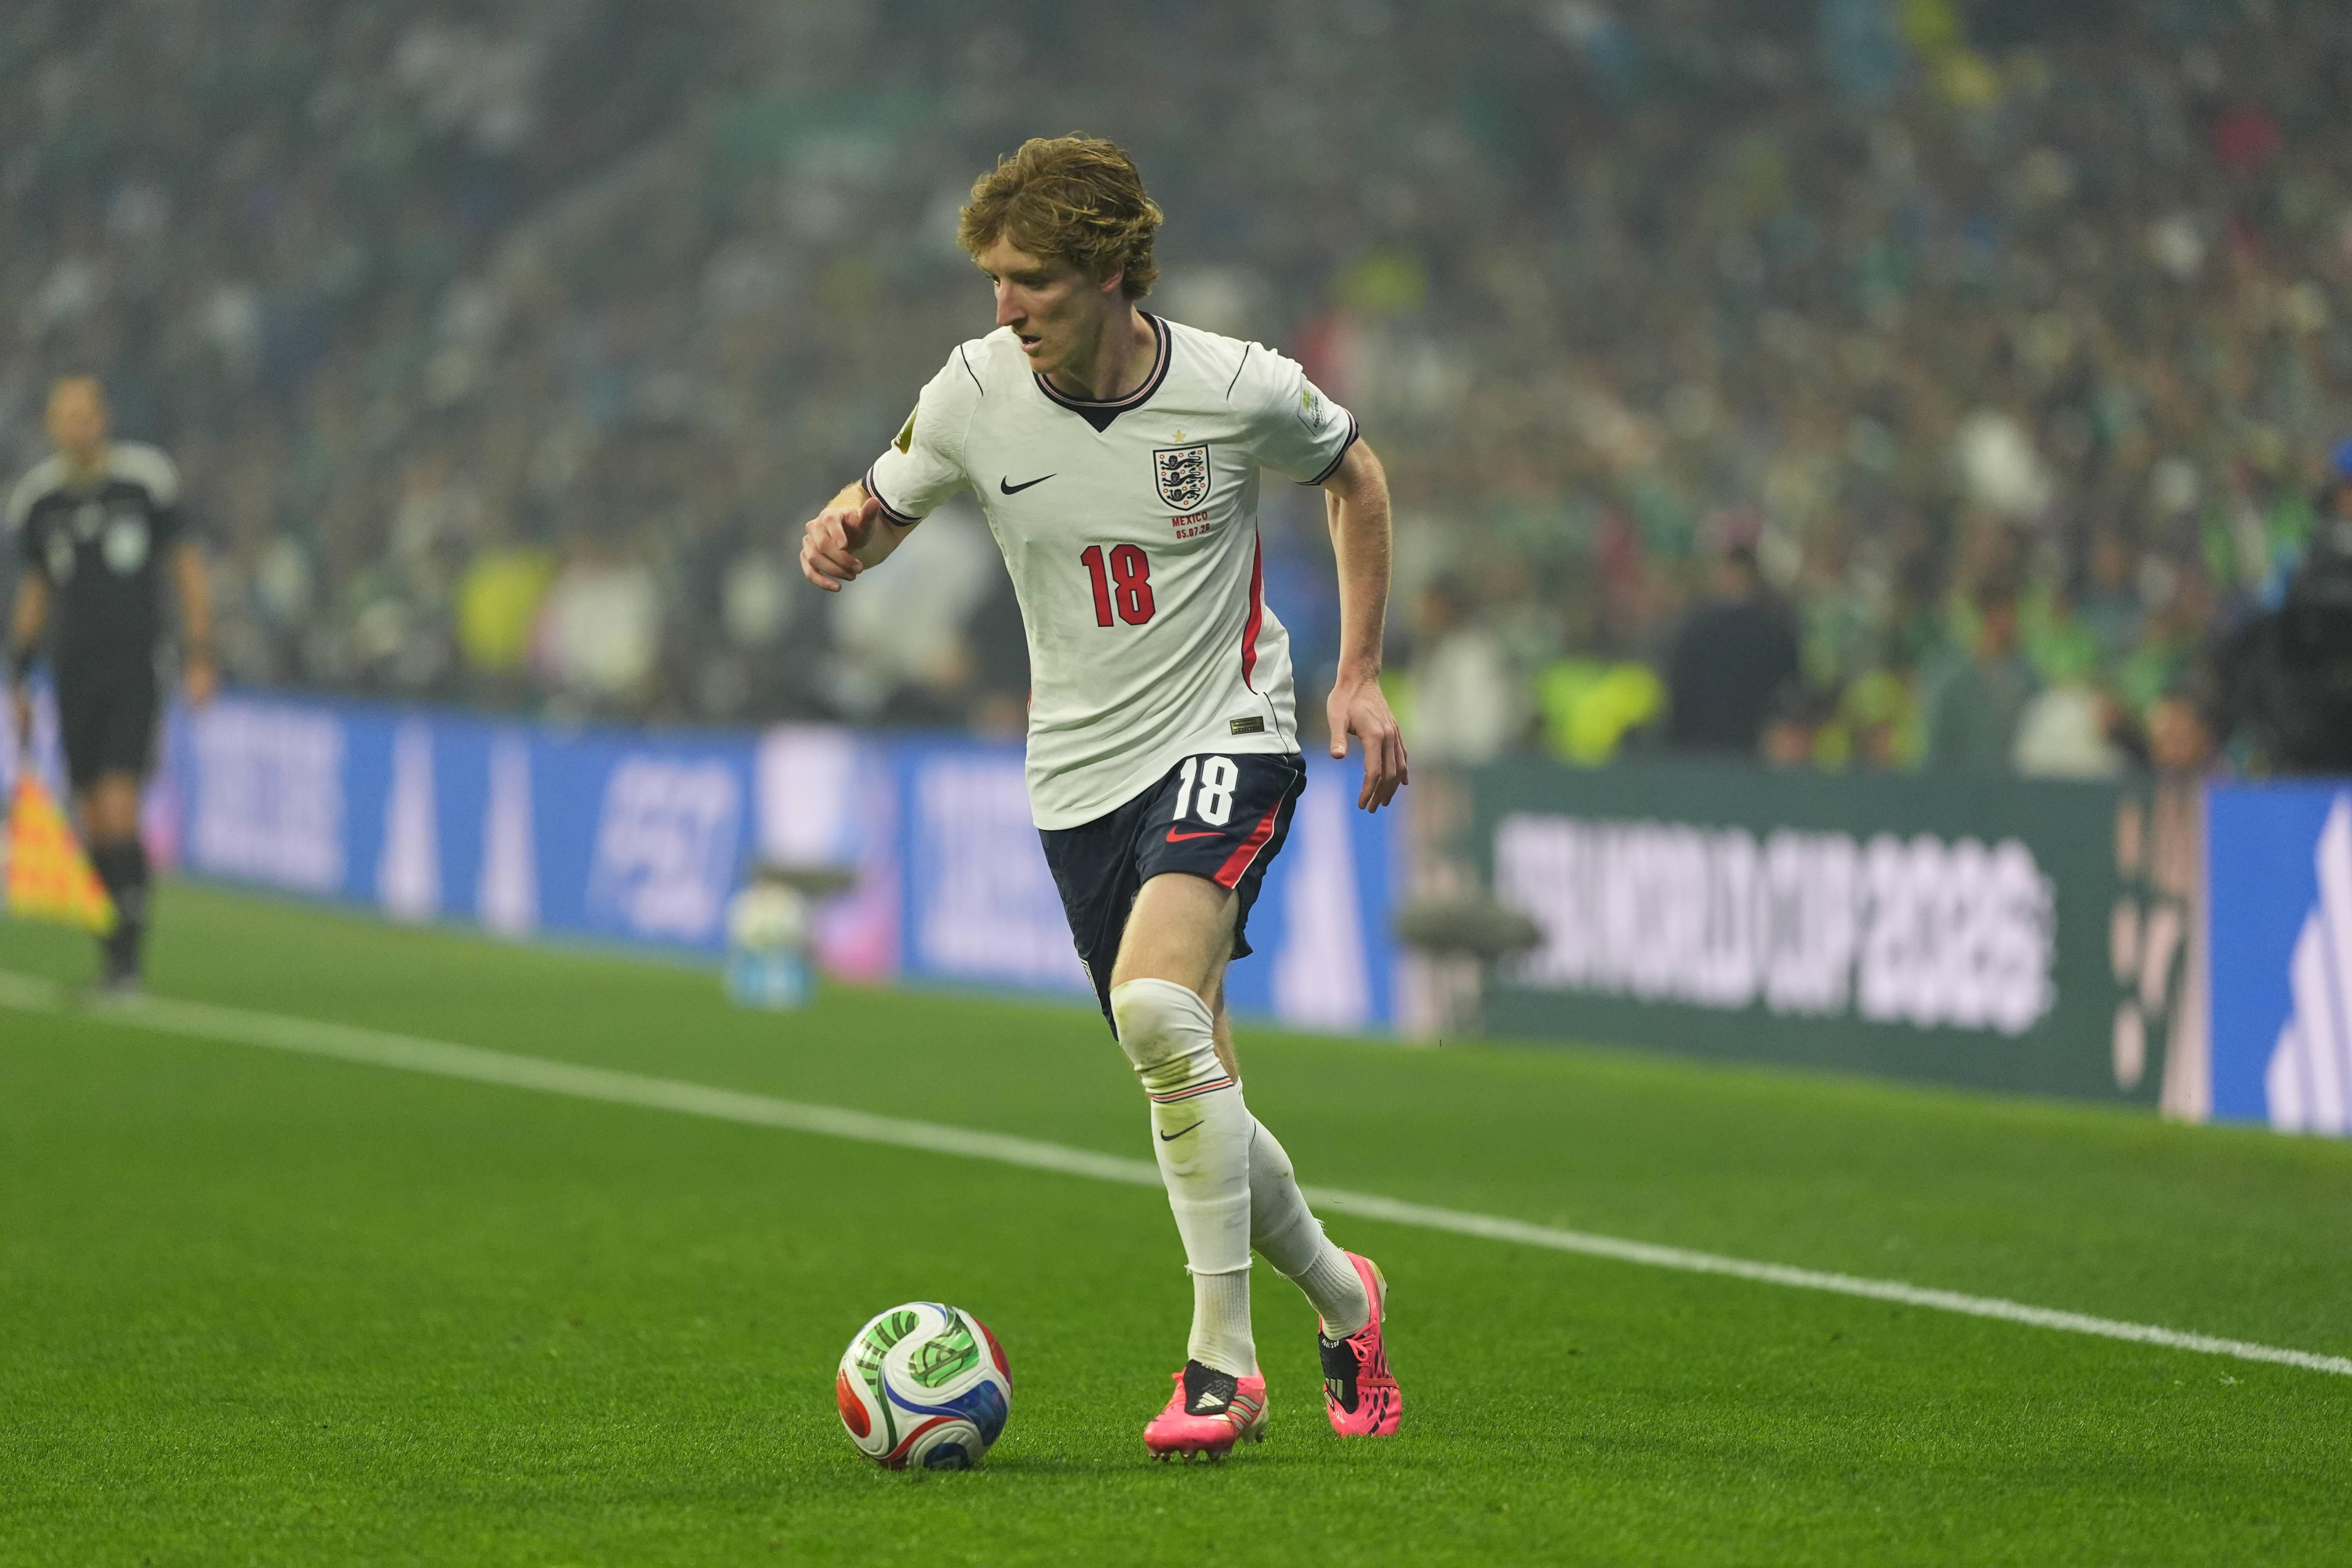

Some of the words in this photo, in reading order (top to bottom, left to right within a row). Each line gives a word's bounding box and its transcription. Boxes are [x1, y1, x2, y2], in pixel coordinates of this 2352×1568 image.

[1172, 511, 1207, 527] MEXICO
[1176, 523, 1210, 539] 05.07.26
[1080, 544, 1156, 627] 18
[1172, 755, 1240, 827] 18
[1322, 1338, 1330, 1348] 1994
